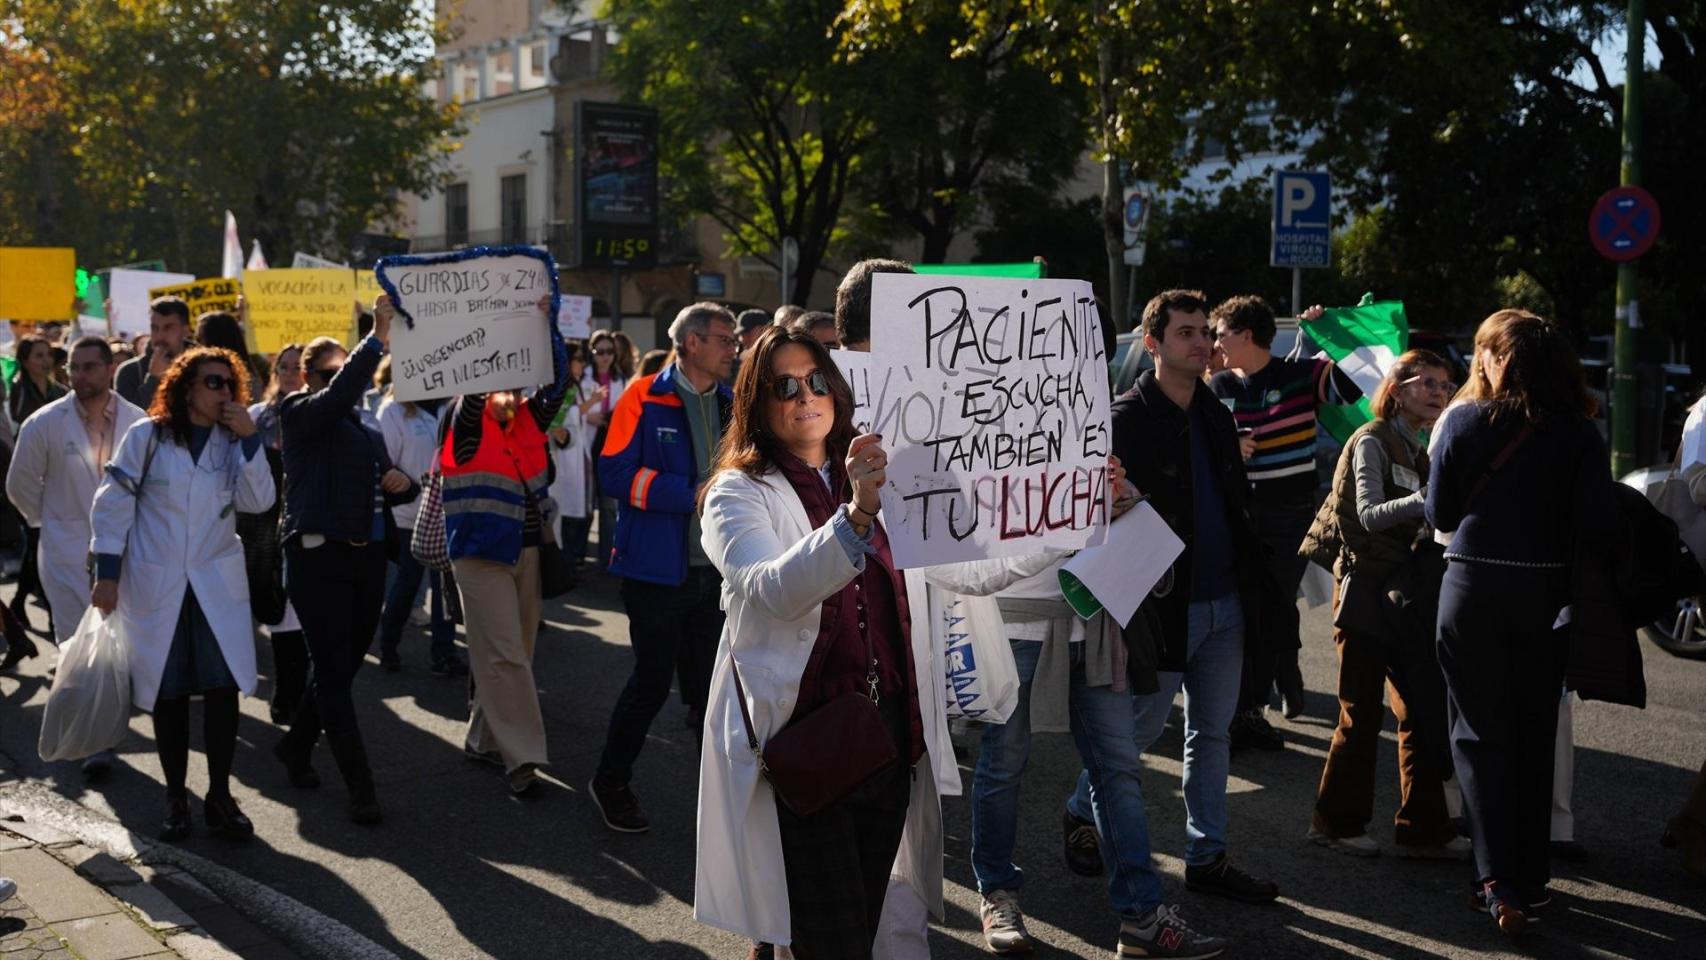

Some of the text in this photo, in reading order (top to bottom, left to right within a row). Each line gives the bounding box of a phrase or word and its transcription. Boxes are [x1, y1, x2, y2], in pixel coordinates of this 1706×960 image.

[1281, 177, 1315, 227] P
[1275, 233, 1328, 245] HOSPITAL
[1279, 244, 1323, 254] VIRGEN
[399, 269, 491, 296] GUARDIAS
[416, 298, 458, 318] HASTA
[466, 295, 509, 314] BATMAN
[908, 286, 1105, 369] PACIENTE
[422, 369, 445, 392] LA
[1083, 421, 1108, 458] ES
[903, 466, 1107, 542] TU LUCHA
[1157, 926, 1185, 951] N
